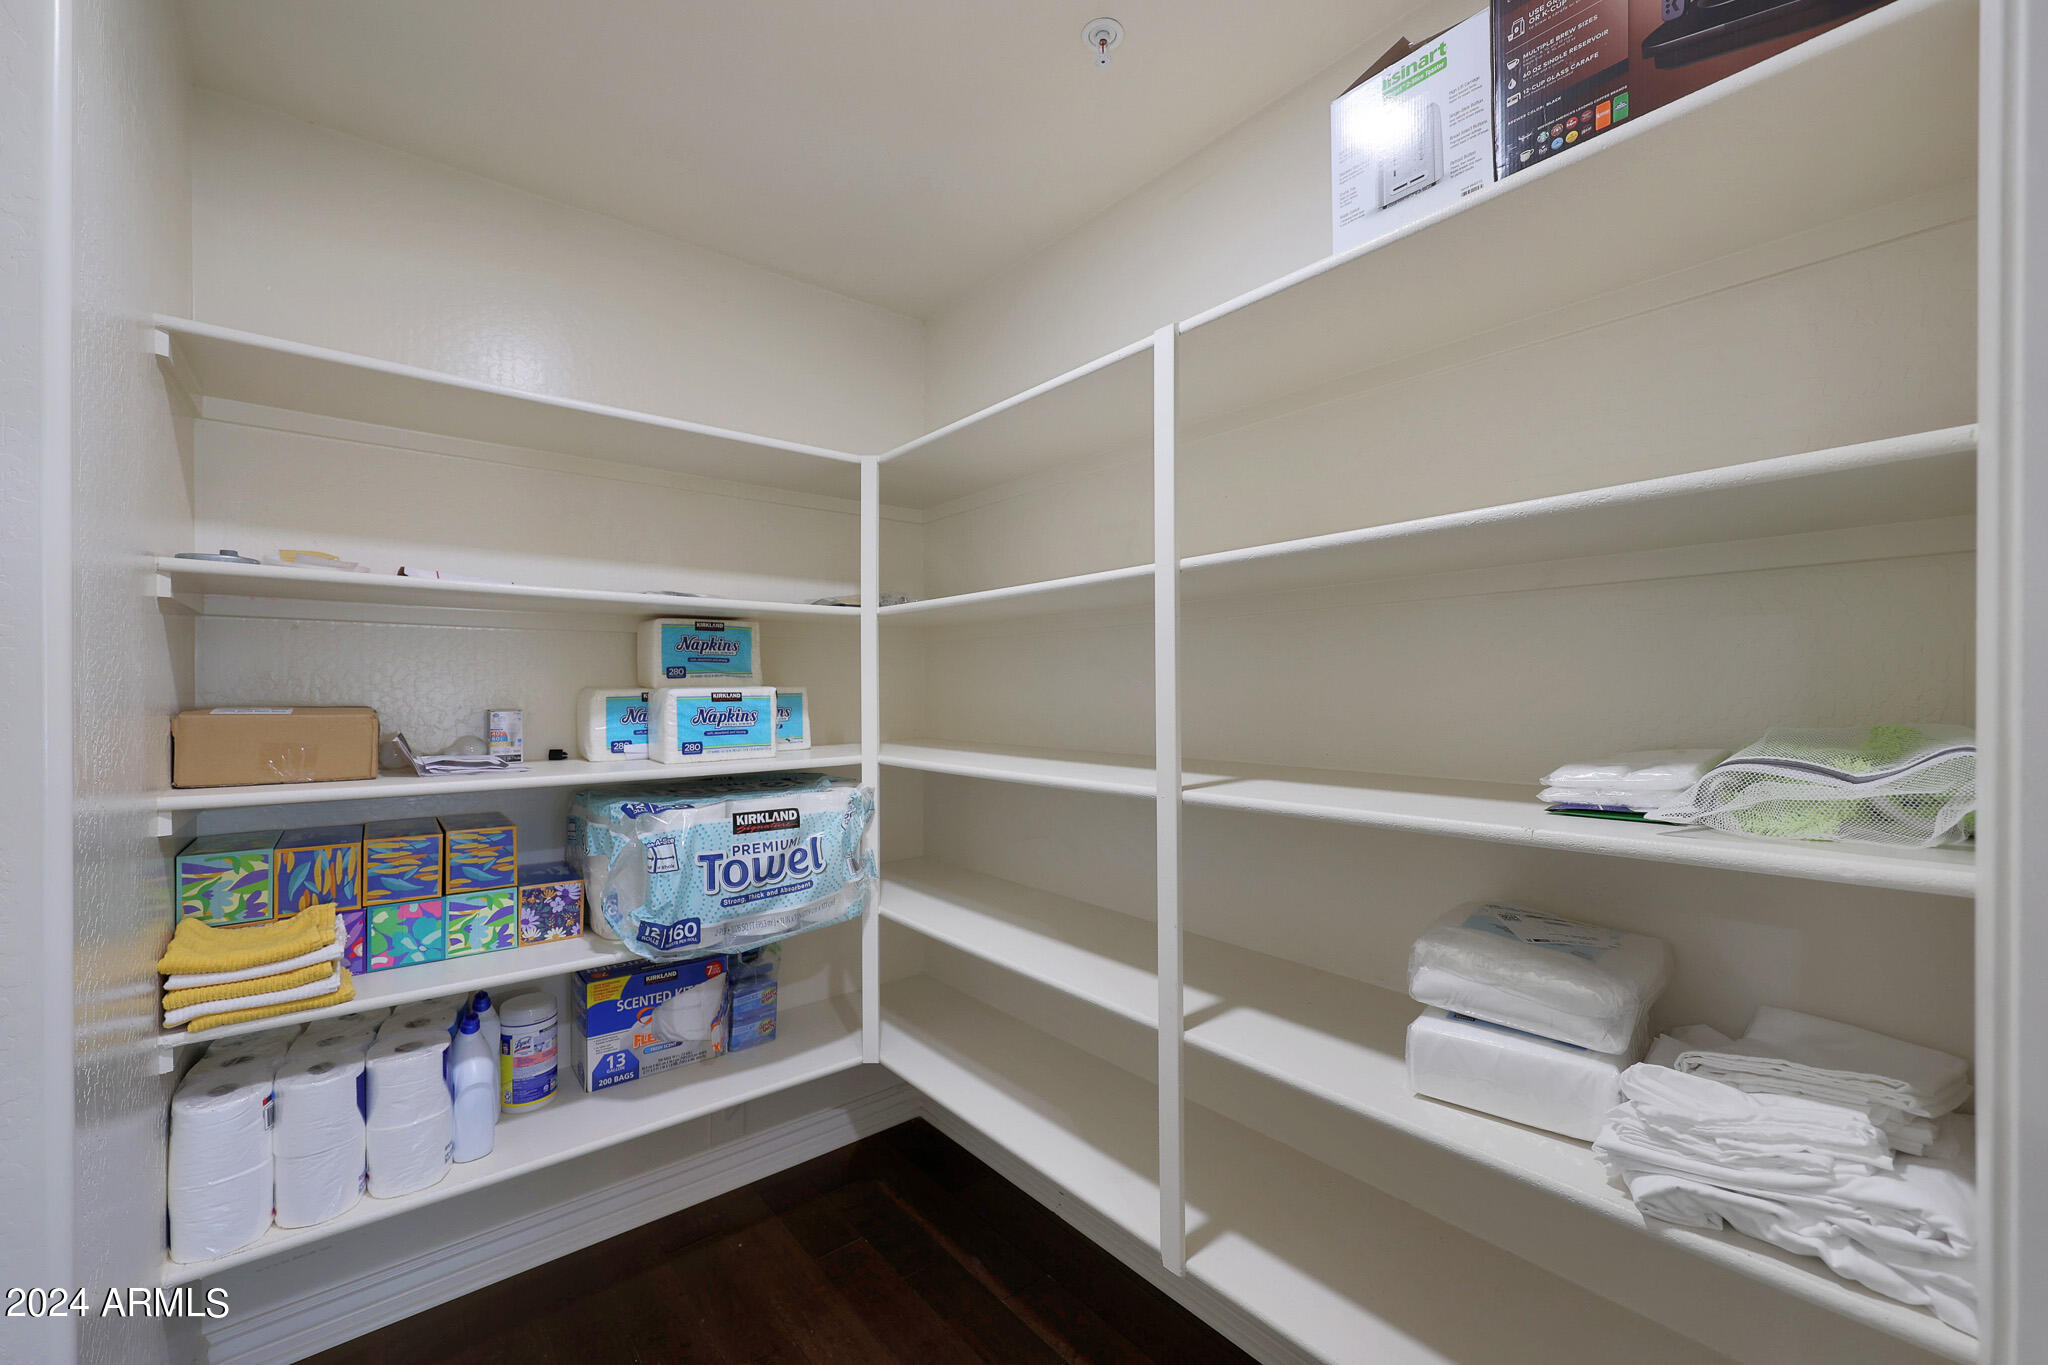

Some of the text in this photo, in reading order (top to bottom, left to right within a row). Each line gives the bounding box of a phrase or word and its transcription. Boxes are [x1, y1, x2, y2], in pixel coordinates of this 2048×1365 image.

[1528, 14, 1540, 24] OR
[1523, 38, 1554, 59] MULTIPLE
[1555, 26, 1576, 42] BREW
[1577, 14, 1598, 30] SIZES
[1532, 64, 1542, 73] OZ
[1543, 51, 1567, 68] SINGLE
[1569, 29, 1609, 54] RESERVOIR
[1522, 79, 1546, 95] 12-CUP
[1546, 67, 1569, 83] GLASS
[1570, 52, 1599, 70] CARAFE
[1546, 96, 1562, 107] BLACK
[696, 622, 724, 630] KIRKLAND
[676, 635, 740, 655] Napkins
[668, 667, 685, 676] 280
[692, 707, 758, 728] Napkins
[684, 743, 701, 752] 280
[736, 810, 798, 826] KIRKLAND
[733, 837, 799, 856] PREMIUM
[698, 836, 823, 893] Towel
[723, 881, 811, 907] Strong, Thick and Absorbent
[645, 922, 697, 942] 12 160
[641, 936, 660, 945] ROLLS
[646, 970, 677, 982] KIRKLAND
[706, 966, 713, 975] 7
[617, 991, 671, 1012] SCENTED
[606, 1053, 626, 1069] 13
[599, 1072, 634, 1087] 200 BAGS
